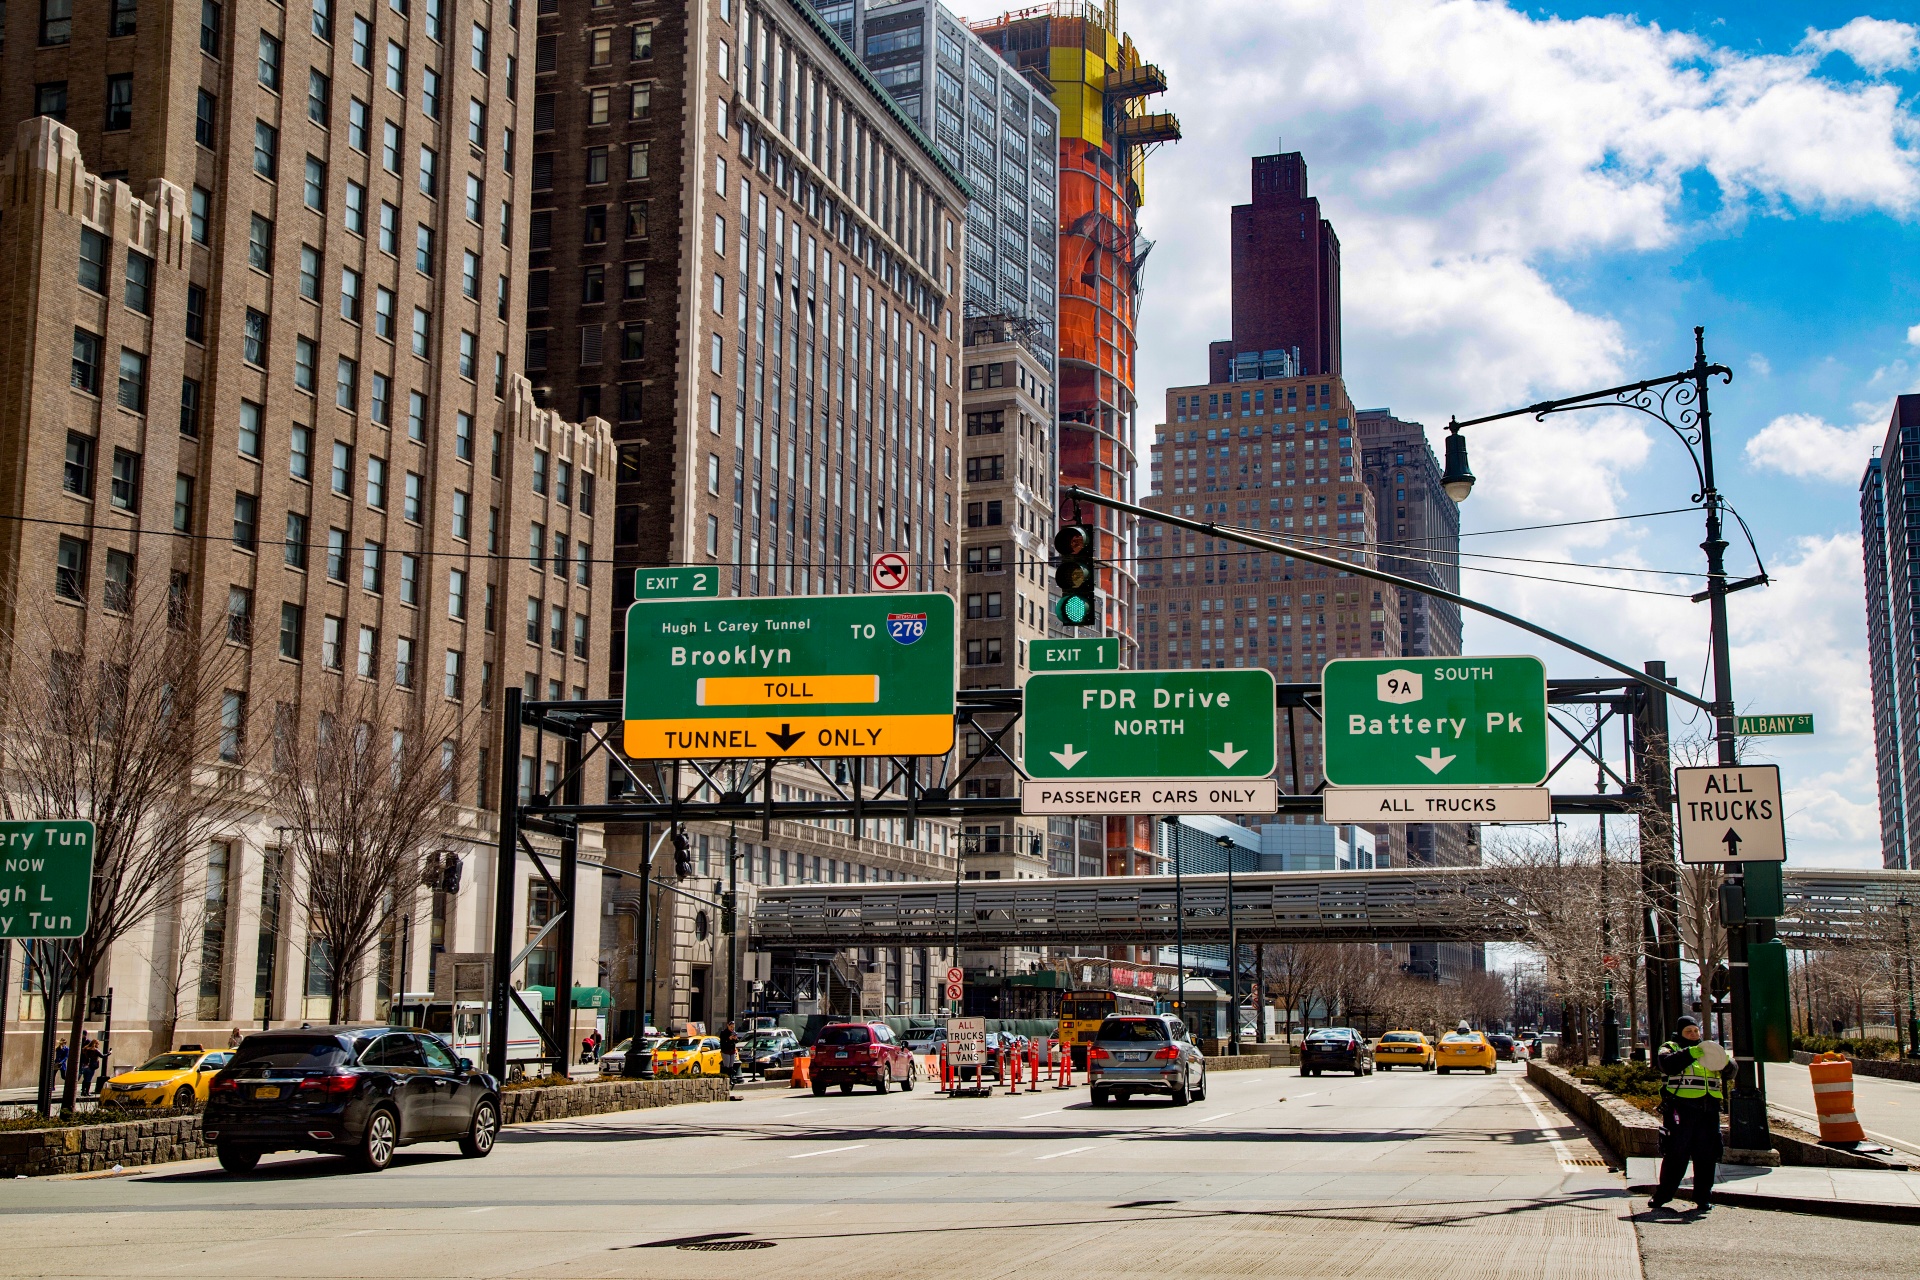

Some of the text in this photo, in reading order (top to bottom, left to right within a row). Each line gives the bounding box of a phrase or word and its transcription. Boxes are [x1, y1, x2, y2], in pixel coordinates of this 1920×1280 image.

[646, 573, 707, 591] EXIT 2
[662, 618, 810, 635] Hugh L Carey Tunnel
[851, 624, 876, 640] TO
[892, 621, 923, 637] 278
[671, 645, 791, 668] Brooklyn
[1046, 645, 1104, 663] EXIT 1
[1434, 667, 1493, 681] SOUTH
[764, 683, 813, 698] TOLL
[1387, 678, 1411, 695] 9A
[1083, 688, 1231, 709] FDR Drive
[1114, 719, 1184, 735] NORTH
[1349, 711, 1523, 739] Battery Pk
[1741, 716, 1810, 734] ALBANY ST
[665, 728, 883, 748] TUNNEL ONLY
[1704, 773, 1753, 794] ALL
[1042, 789, 1256, 804] PASSENGER CARS ONLY
[1380, 798, 1497, 812] ALL TRUCKS
[1687, 799, 1773, 821] TRUCKS
[45, 829, 87, 846] Tun
[5, 859, 45, 872] NOW
[41, 885, 53, 901] L
[29, 912, 72, 929] Tun
[958, 1021, 974, 1029] ALL
[950, 1032, 984, 1040] TRUCKS
[958, 1043, 976, 1051] AND
[956, 1053, 979, 1061] VANS
